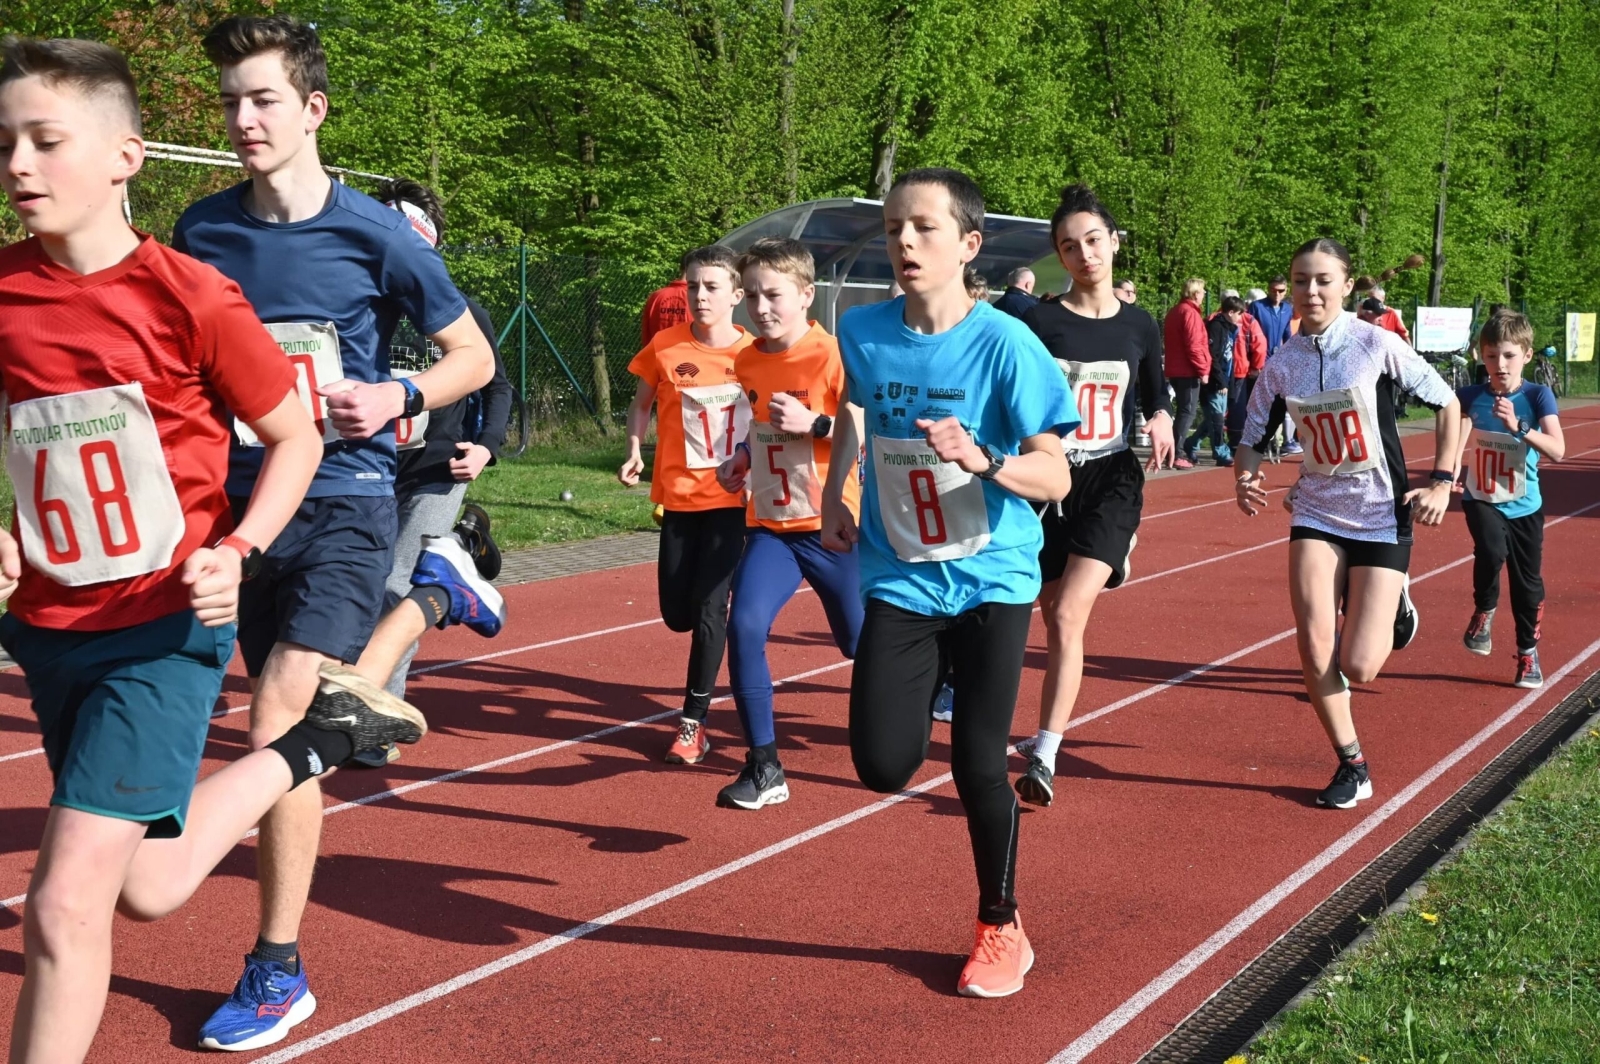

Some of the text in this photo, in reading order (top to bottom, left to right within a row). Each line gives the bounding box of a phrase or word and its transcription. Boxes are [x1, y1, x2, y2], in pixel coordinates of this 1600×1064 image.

[277, 339, 322, 353] TRUTNOV
[927, 388, 965, 396] MARATON
[1090, 372, 1119, 381] TRUTNOV
[715, 392, 742, 403] TRUTNOV
[1075, 383, 1119, 440] 03
[1298, 399, 1353, 414] PIVOVAR TRUTNOV
[14, 412, 127, 445] PIVOVAR TRUTNOV
[698, 405, 737, 458] 17
[1302, 410, 1368, 465] 108
[883, 453, 943, 466] PIVOVAR TRU
[1494, 442, 1519, 451] TRUTNOV
[767, 445, 791, 506] 5
[1475, 448, 1515, 494] 104
[34, 440, 141, 565] 68
[908, 469, 947, 545] 8
